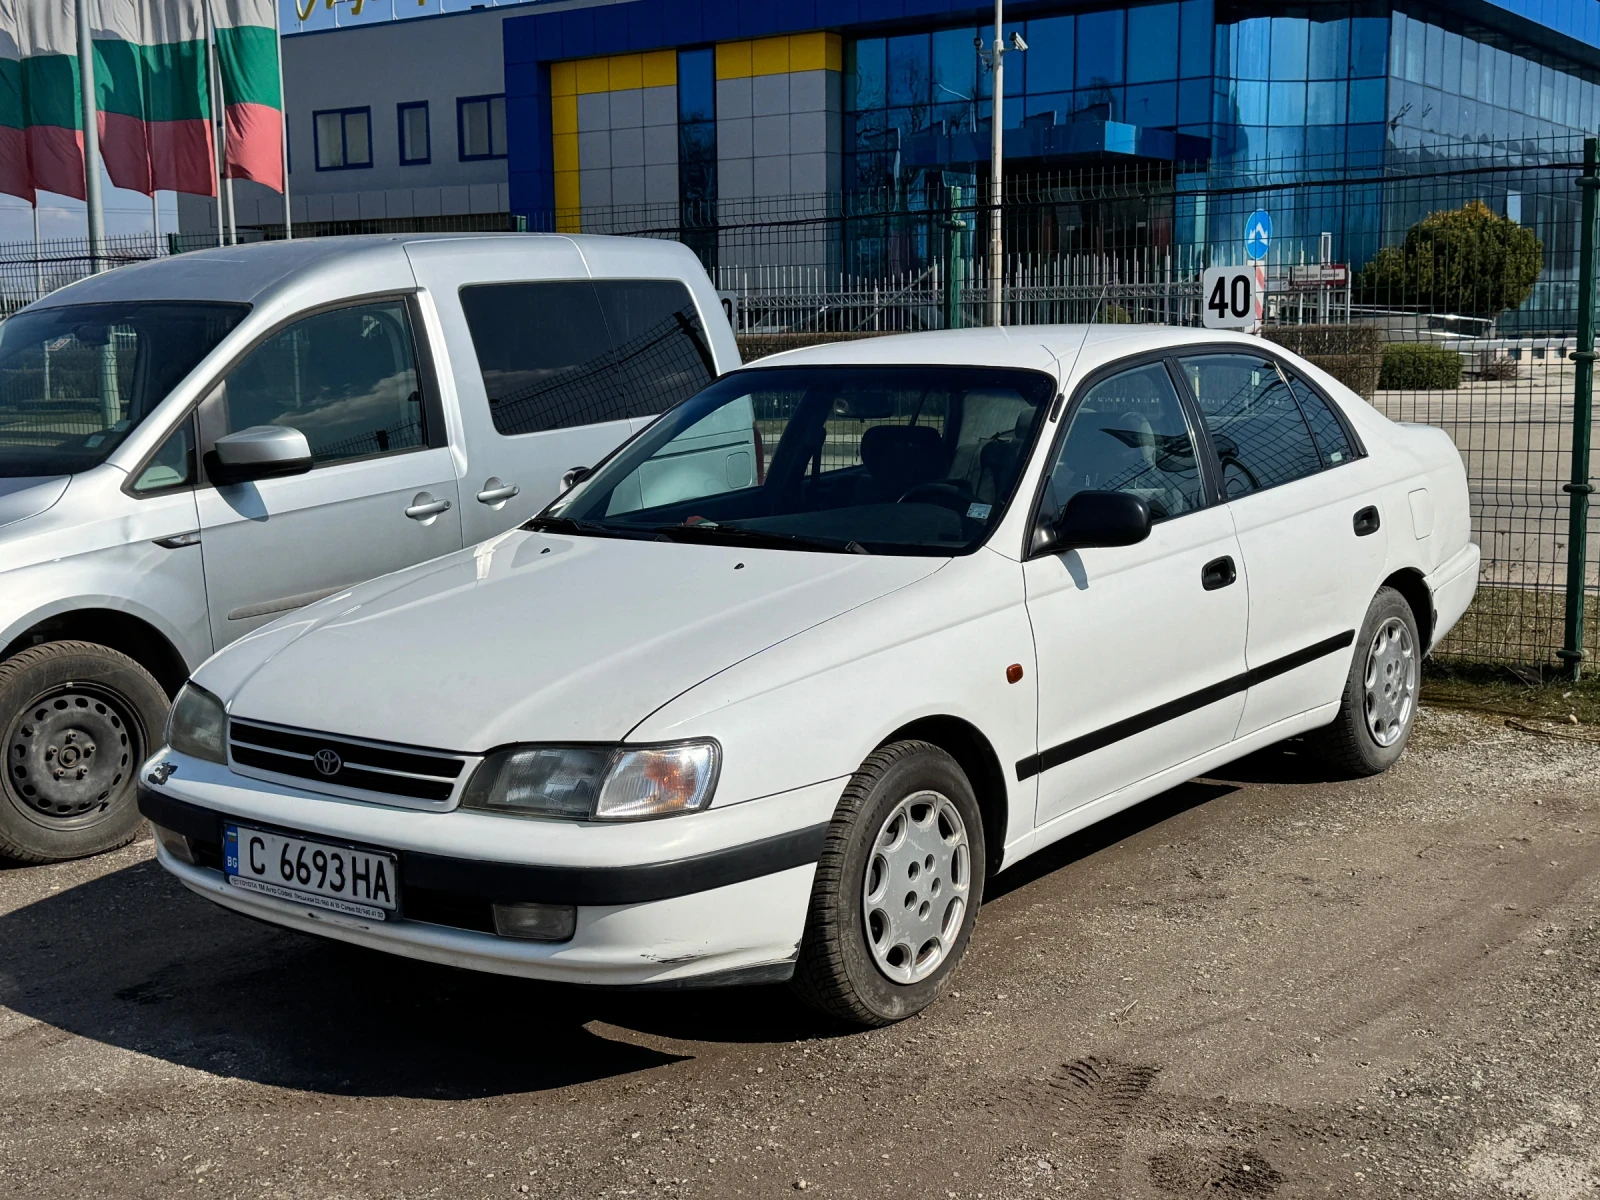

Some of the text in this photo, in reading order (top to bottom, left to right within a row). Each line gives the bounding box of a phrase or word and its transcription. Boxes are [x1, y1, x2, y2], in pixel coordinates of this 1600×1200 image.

[1208, 274, 1250, 319] 40
[227, 856, 238, 868] BG
[249, 836, 391, 903] C 6693 HA
[240, 880, 257, 889] TOYOTA
